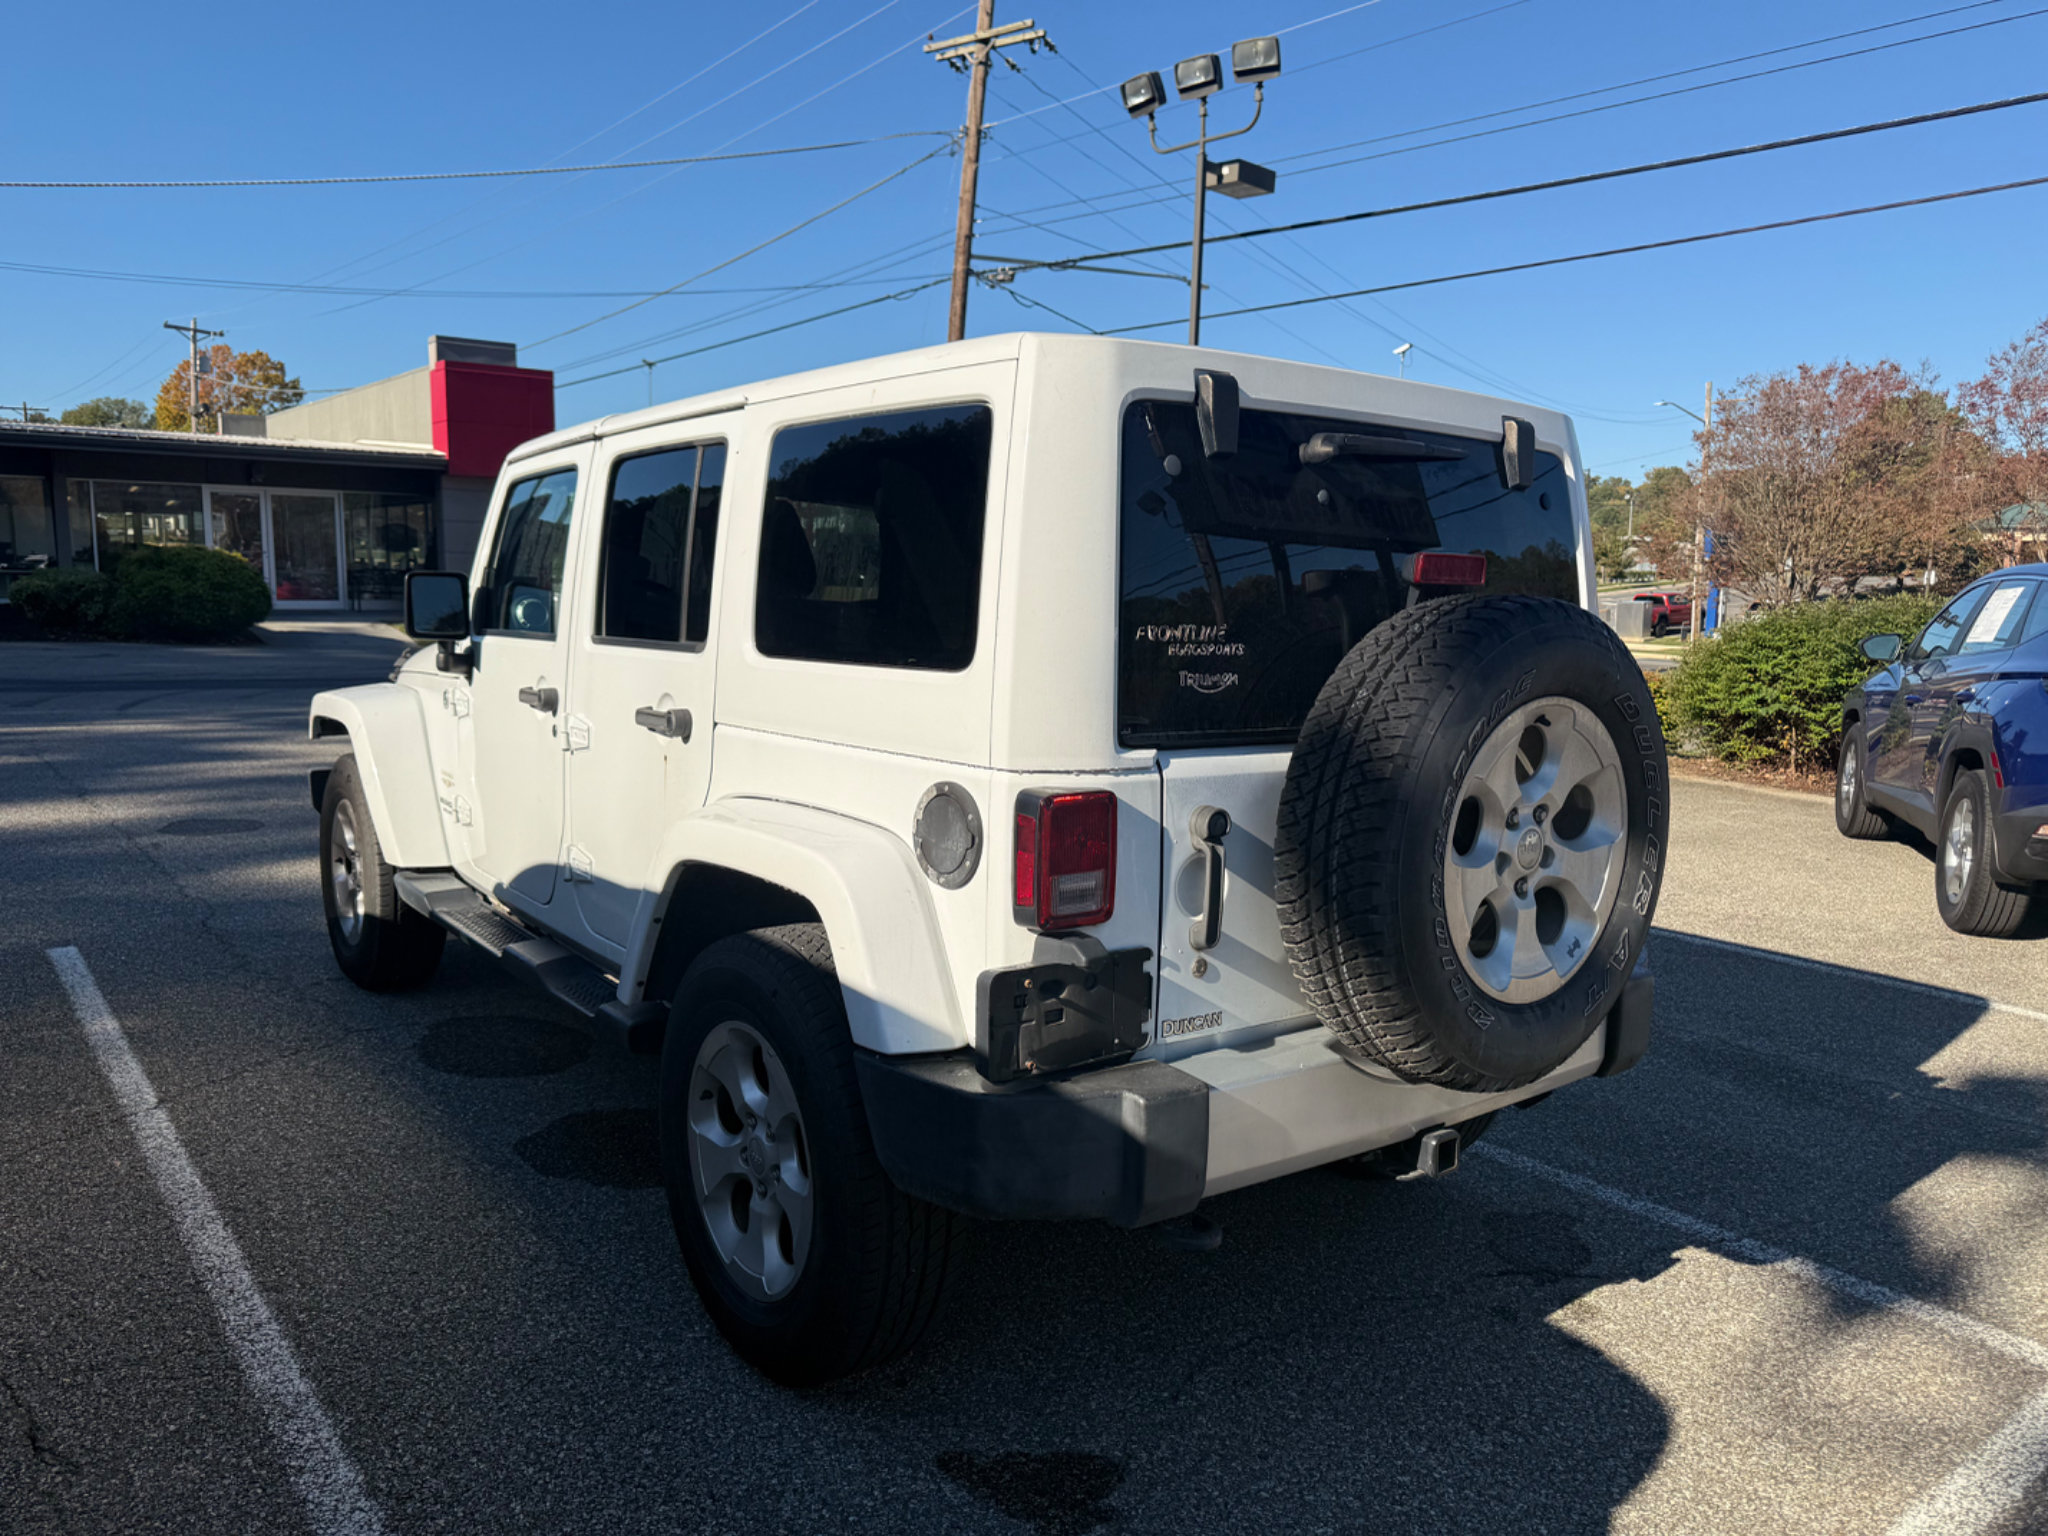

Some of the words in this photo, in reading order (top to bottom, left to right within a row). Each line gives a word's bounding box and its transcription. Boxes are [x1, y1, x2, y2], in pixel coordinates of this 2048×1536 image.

[1135, 624, 1228, 642] FRONTLINE
[1178, 671, 1239, 690] TRIUMPH
[1614, 692, 1662, 916] DUELER
[1161, 1010, 1223, 1038] DUNCAN
